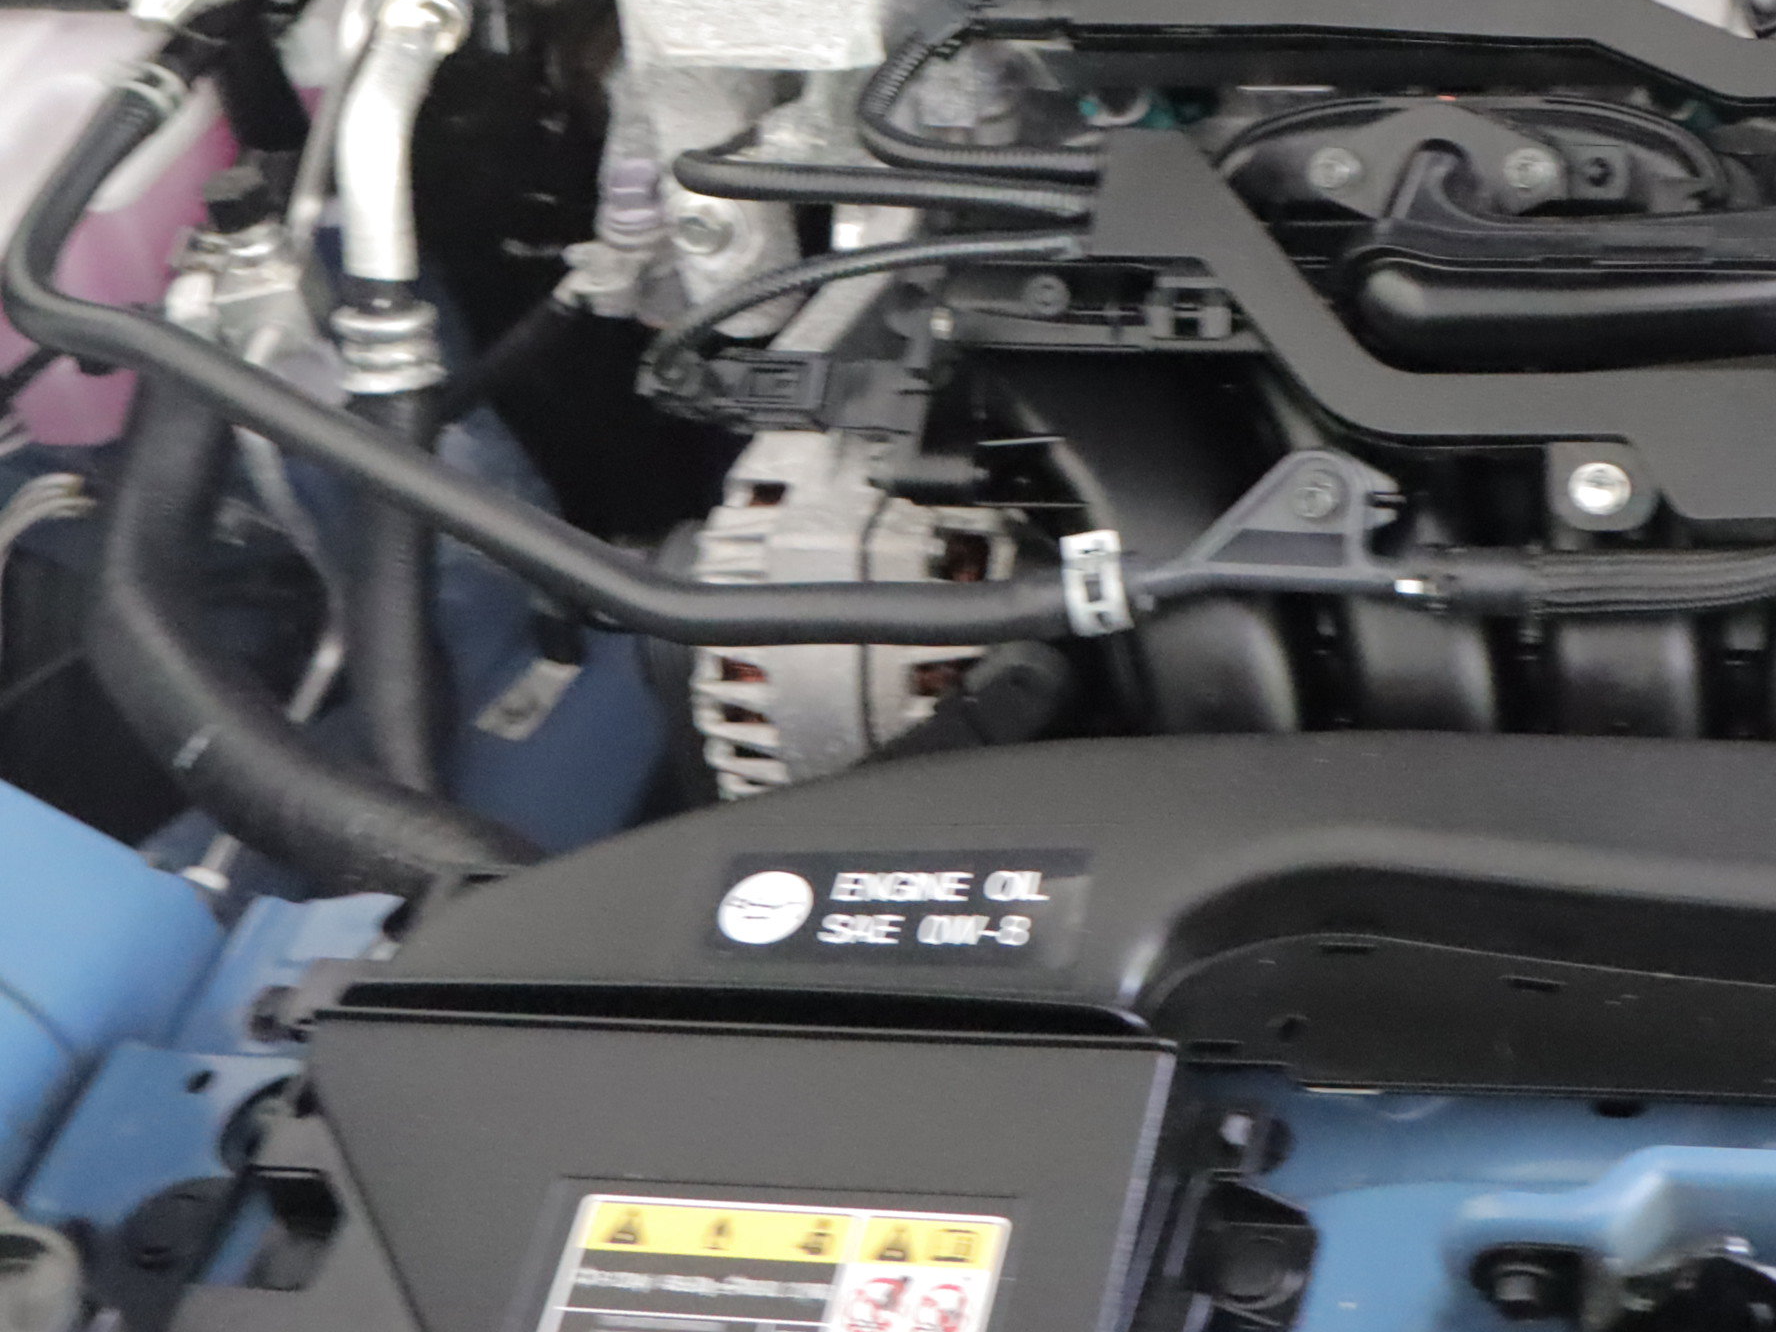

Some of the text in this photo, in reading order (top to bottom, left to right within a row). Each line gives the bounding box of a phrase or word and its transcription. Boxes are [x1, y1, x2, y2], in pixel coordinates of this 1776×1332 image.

[829, 870, 1050, 902] ENGINE OIL
[816, 913, 906, 945] SAE
